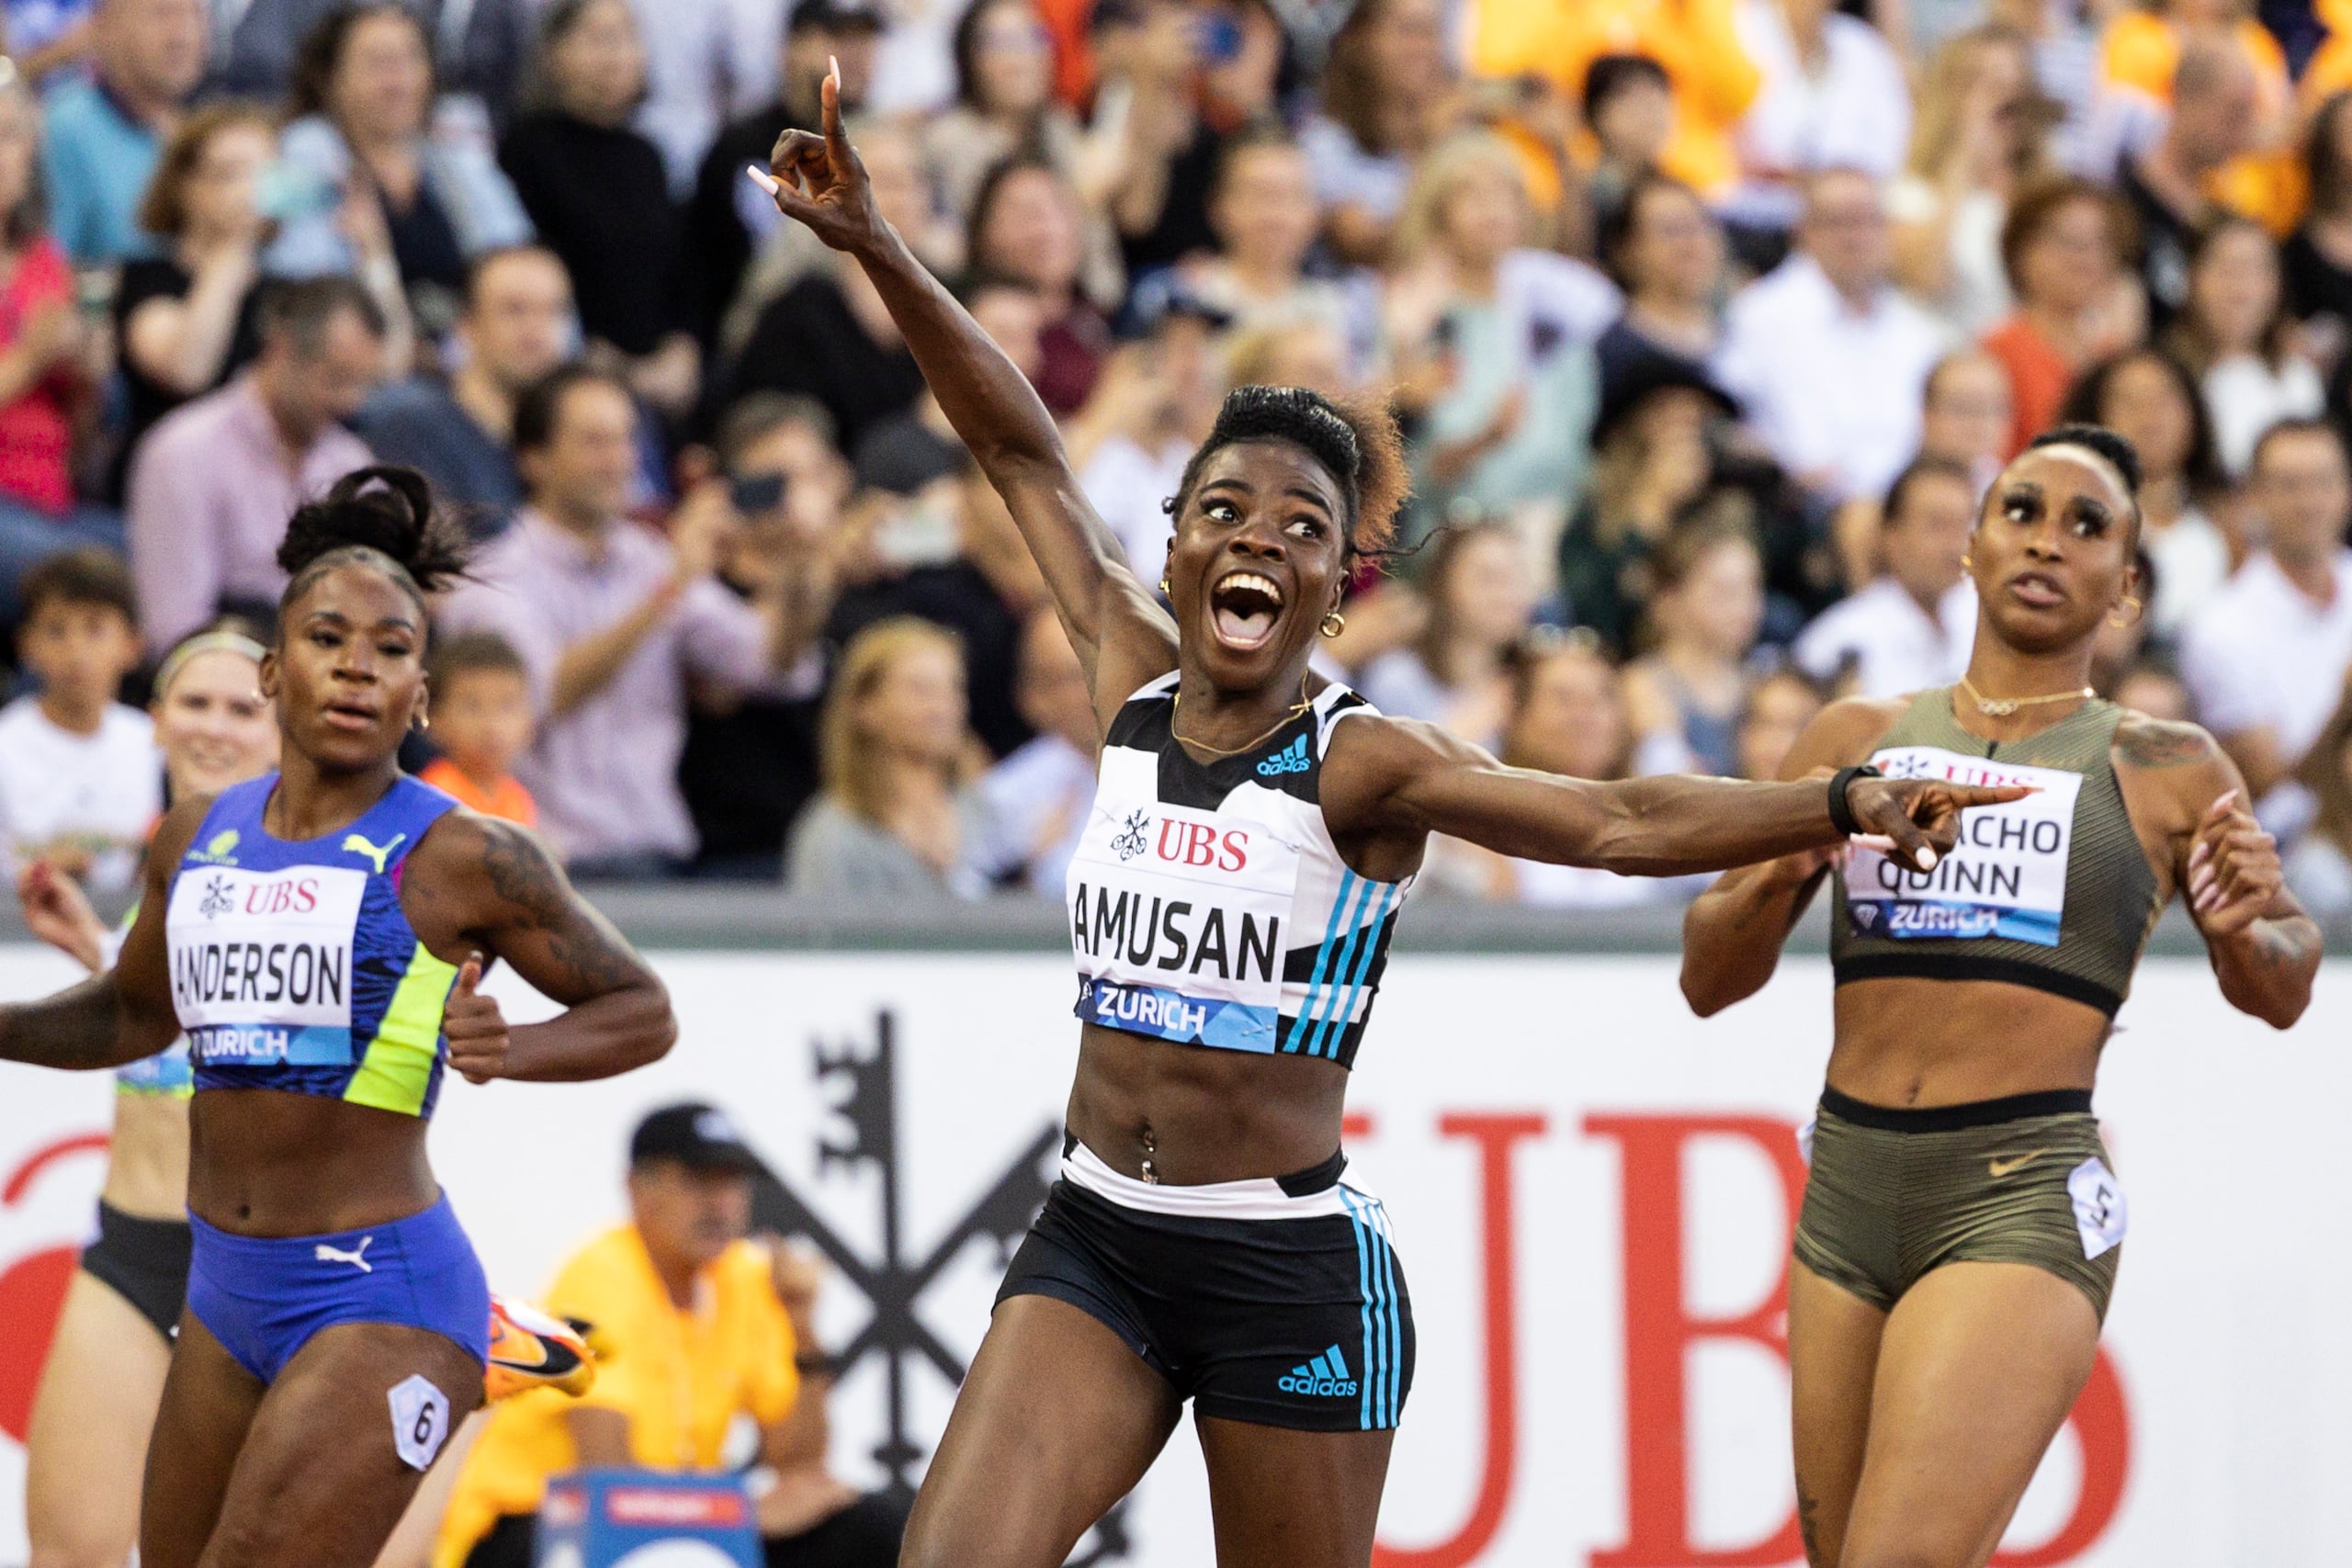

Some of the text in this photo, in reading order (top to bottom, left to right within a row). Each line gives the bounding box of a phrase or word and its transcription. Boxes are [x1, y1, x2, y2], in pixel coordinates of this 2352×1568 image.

[1257, 757, 1311, 776] adidas
[1157, 818, 1250, 873] UBS
[244, 877, 319, 916] UBS
[1074, 882, 1280, 984] AMUSAN
[1888, 904, 1999, 931] ZURICH
[177, 942, 344, 1006] ANDERSON
[1096, 986, 1206, 1035] ZURICH
[200, 1029, 289, 1057] ZURICH
[1278, 1374, 1358, 1397] adidas
[414, 1401, 435, 1445] 6
